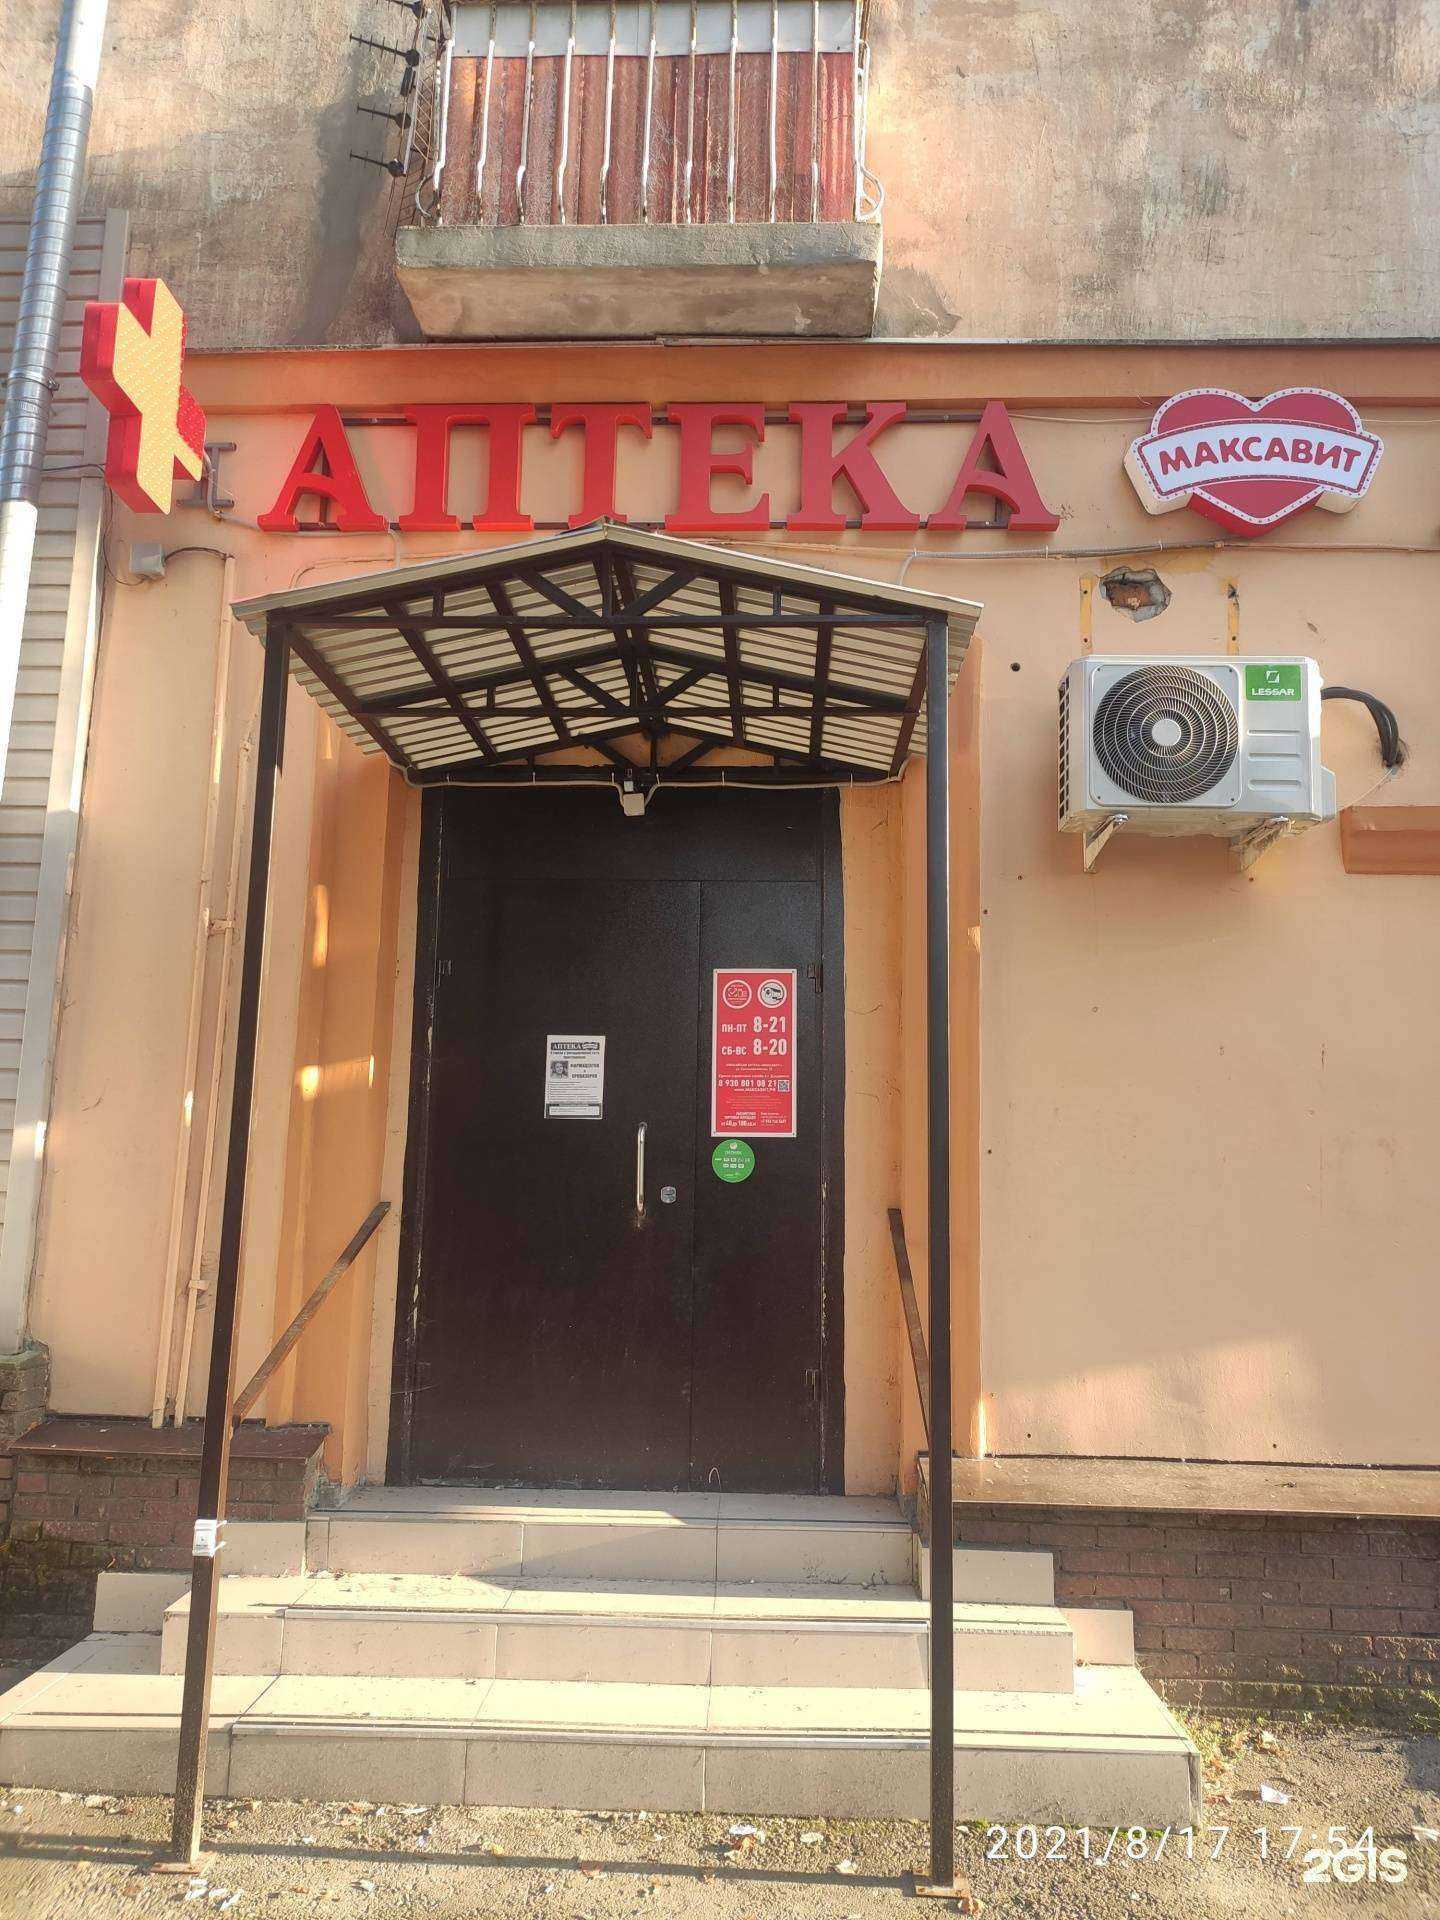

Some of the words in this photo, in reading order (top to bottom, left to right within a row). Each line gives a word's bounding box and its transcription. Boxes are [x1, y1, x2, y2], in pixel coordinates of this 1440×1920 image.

[1158, 435, 1362, 476] МАКСАВИТ
[258, 400, 1060, 533] АПТЕКА
[1251, 687, 1295, 696] LESSAR
[721, 1023, 748, 1033] ПН-ПТ
[753, 1015, 786, 1033] 8-21
[753, 1038, 787, 1056] 8-20
